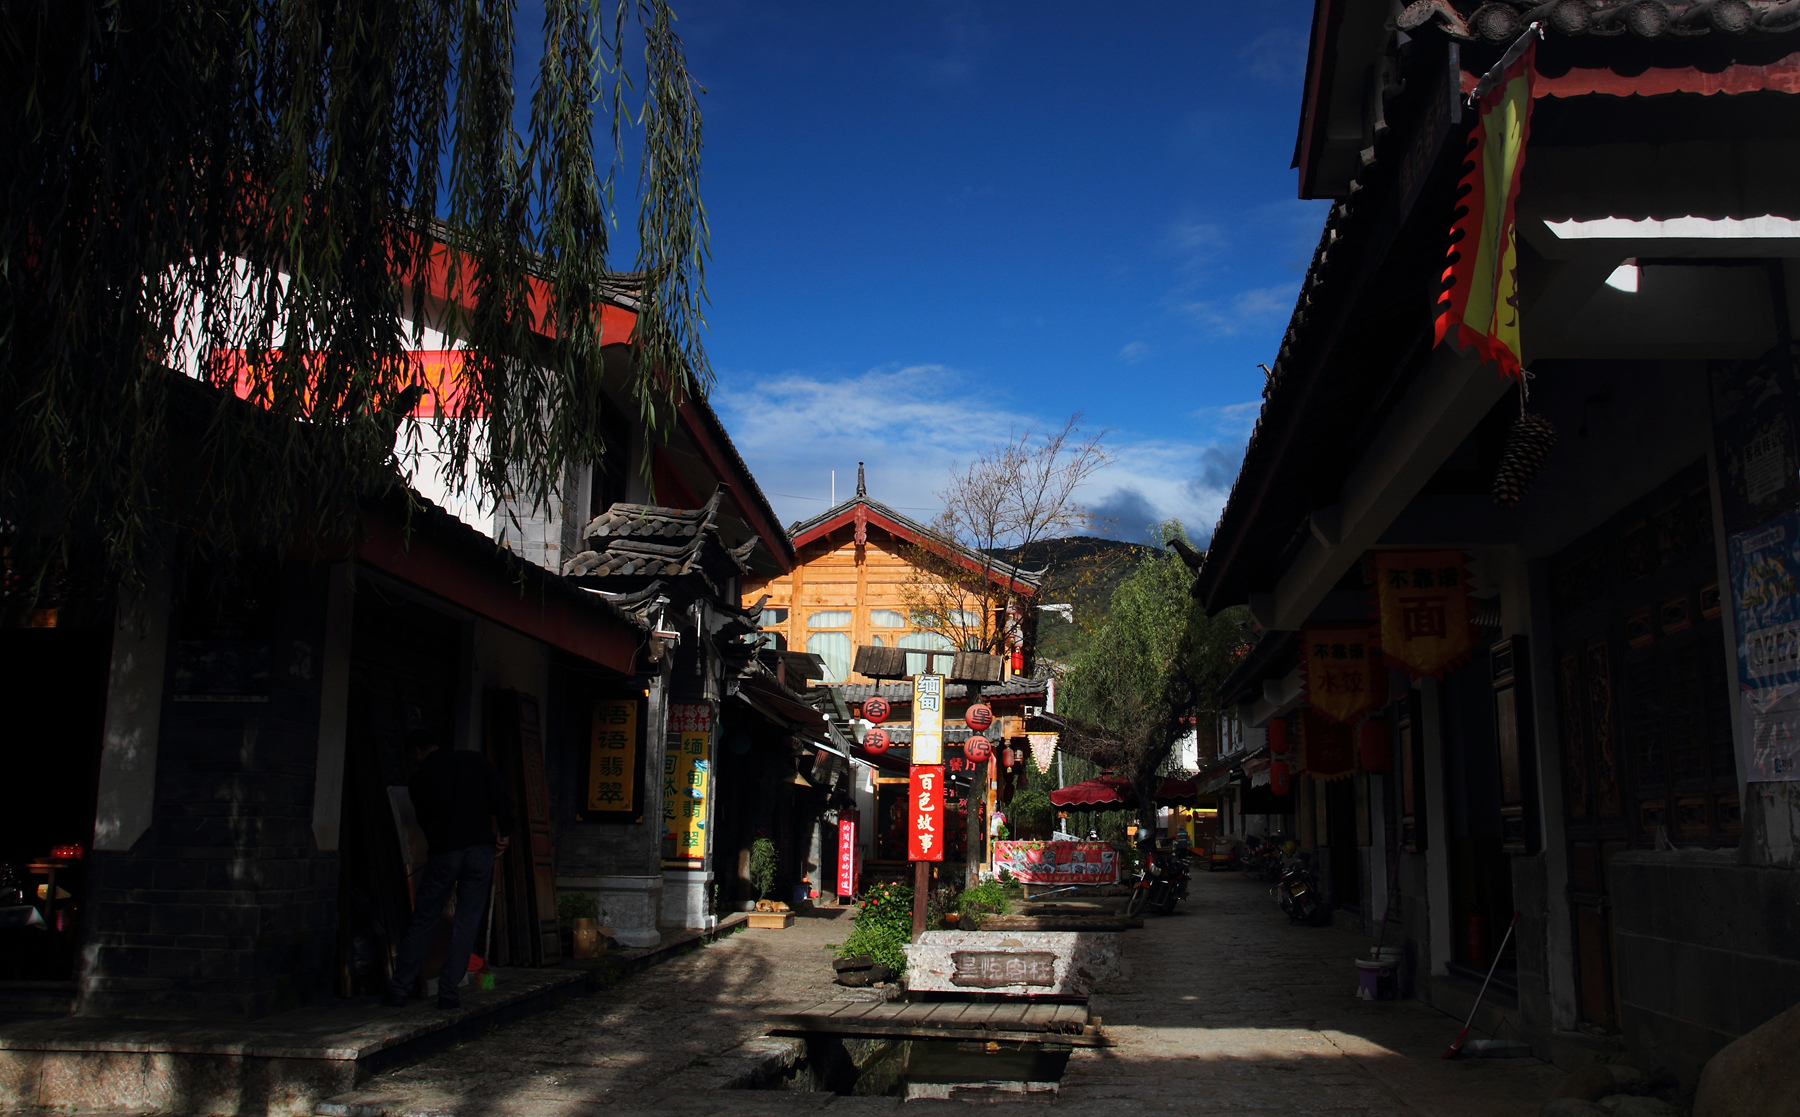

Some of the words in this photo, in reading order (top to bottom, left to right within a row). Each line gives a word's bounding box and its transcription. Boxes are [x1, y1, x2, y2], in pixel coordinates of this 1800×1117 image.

[1388, 567, 1460, 589] 不靠谱
[1314, 643, 1364, 660] 不靠谱
[917, 675, 940, 712] 缅甸
[1317, 670, 1364, 693] 水饺
[598, 705, 630, 804] 悟语翡翠
[943, 757, 977, 772] 餐厅
[682, 738, 703, 848] 缅甸翡翠
[916, 773, 935, 854] 百色故事
